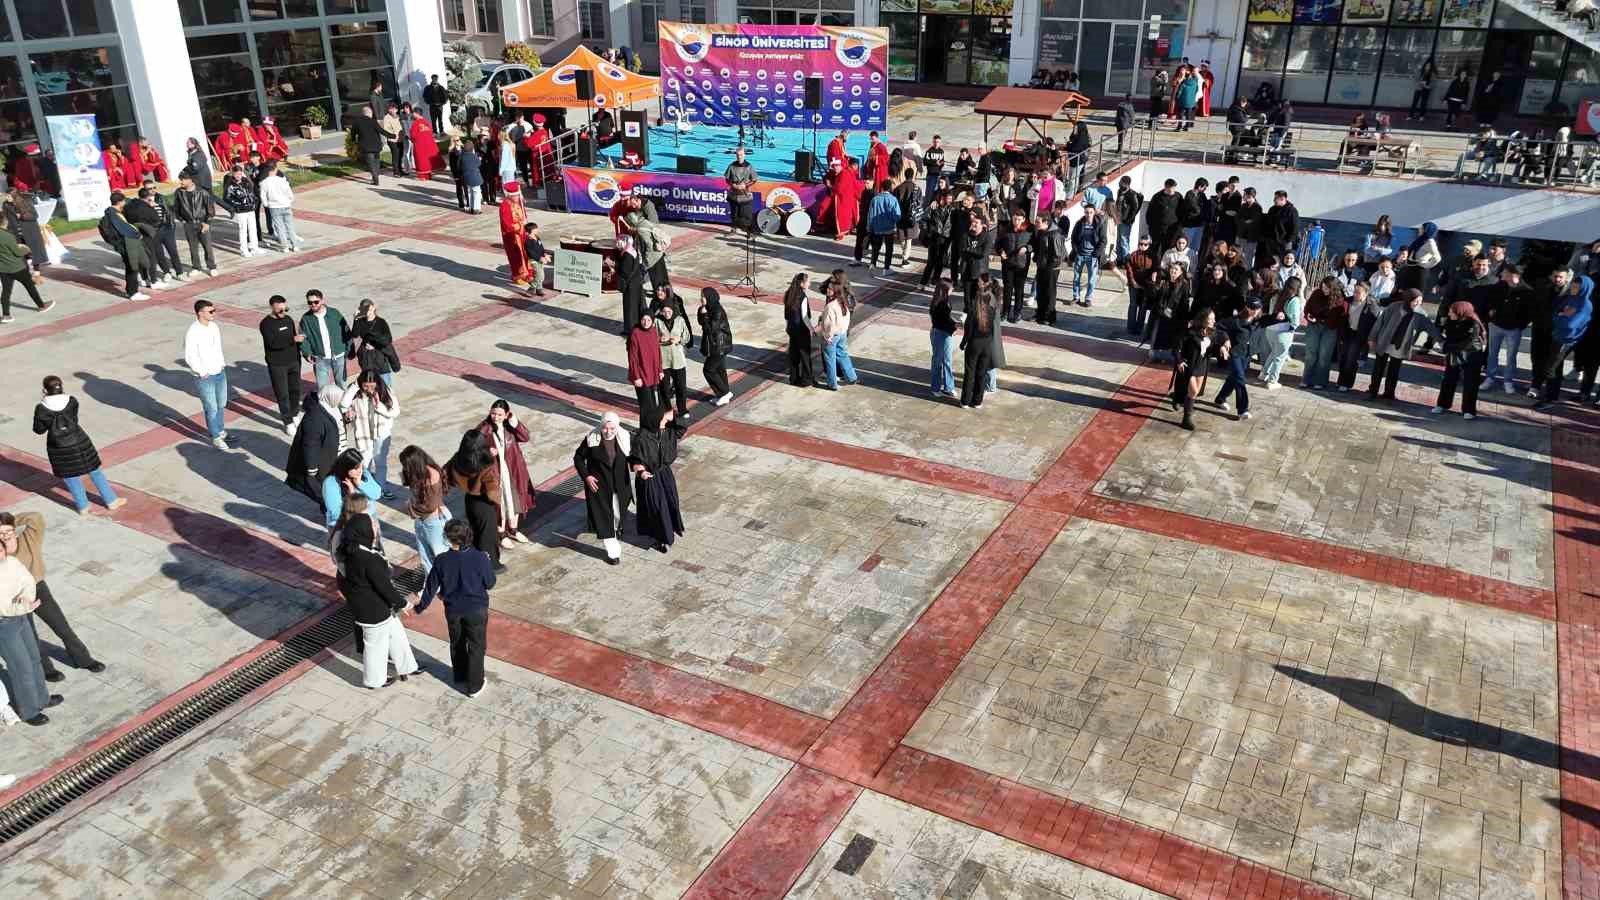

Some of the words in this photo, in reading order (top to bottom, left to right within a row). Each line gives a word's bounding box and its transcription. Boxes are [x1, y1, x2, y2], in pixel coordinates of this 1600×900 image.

[715, 35, 749, 48] SİNOP
[752, 36, 829, 49] ÜNİVERSİTESİ
[633, 184, 670, 198] SİNOP
[672, 186, 728, 203] ÜNİVERSİ
